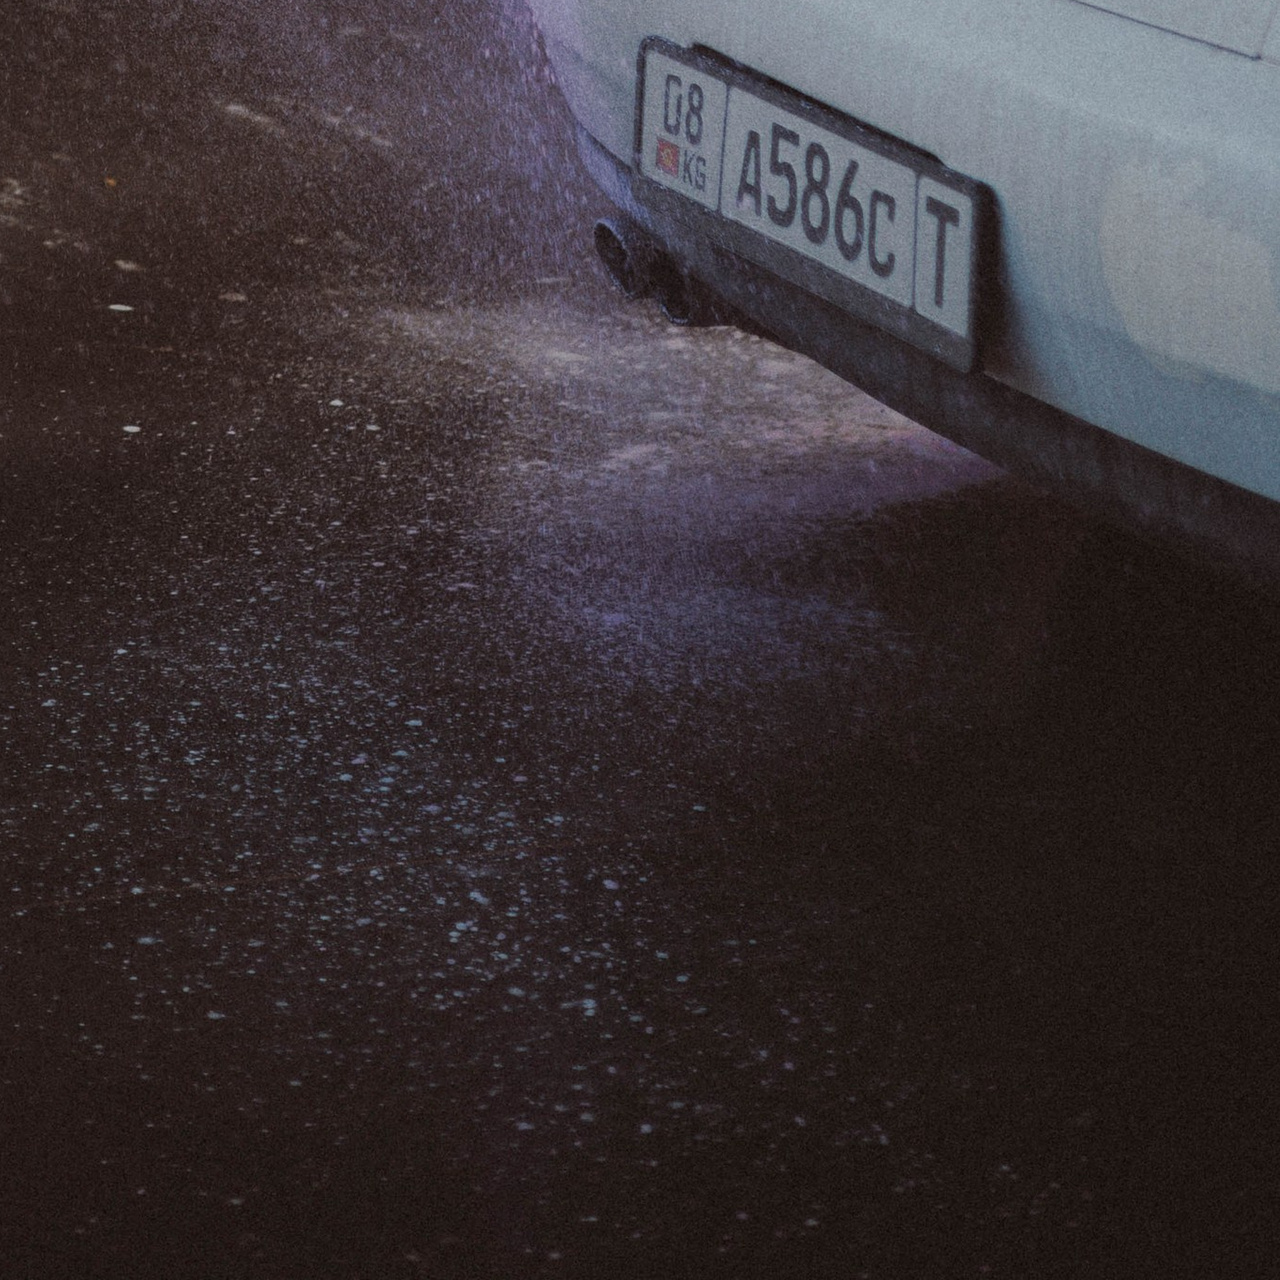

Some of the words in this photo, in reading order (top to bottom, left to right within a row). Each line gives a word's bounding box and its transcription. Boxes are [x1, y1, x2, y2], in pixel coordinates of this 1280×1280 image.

[663, 73, 704, 146] 08
[736, 122, 897, 279] A586C
[925, 195, 961, 309] T
[682, 148, 708, 191] KG
